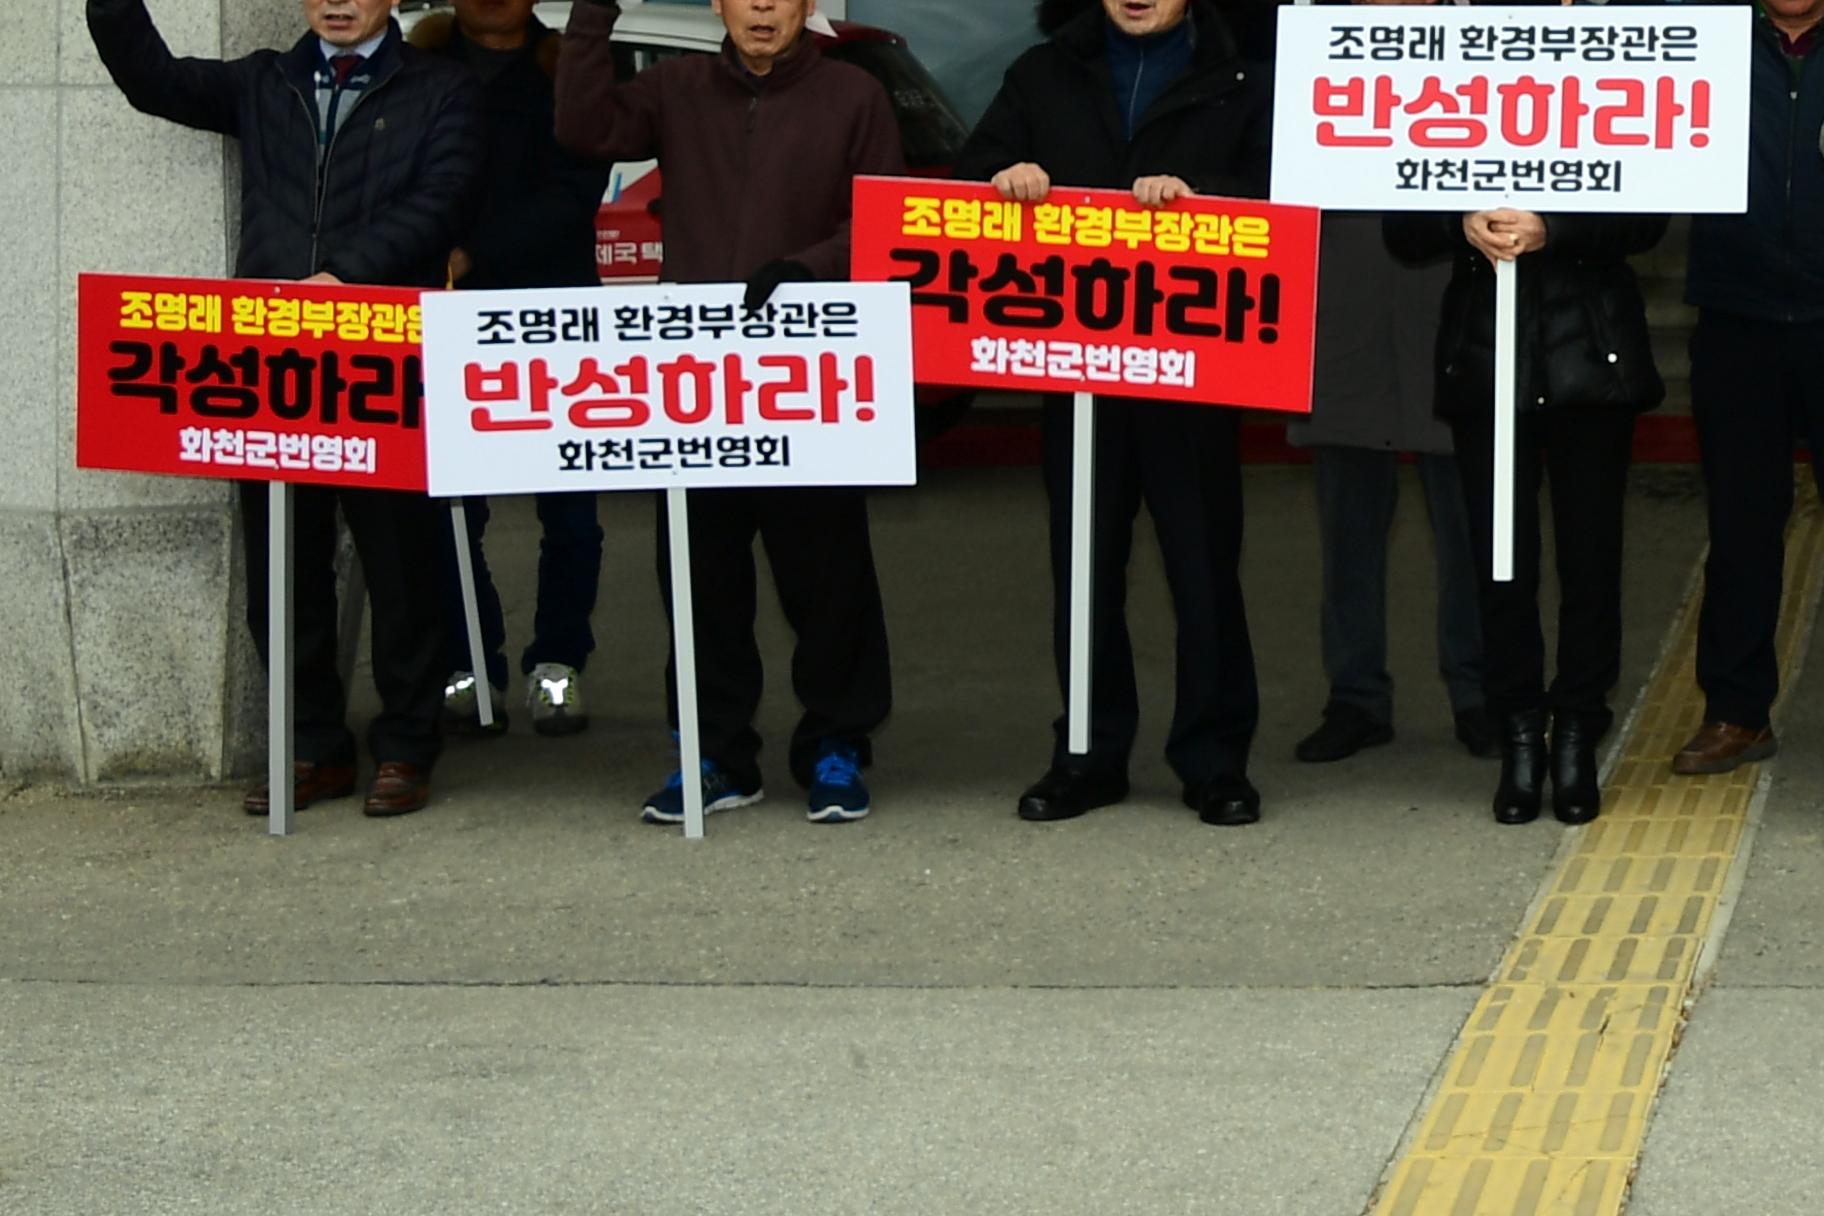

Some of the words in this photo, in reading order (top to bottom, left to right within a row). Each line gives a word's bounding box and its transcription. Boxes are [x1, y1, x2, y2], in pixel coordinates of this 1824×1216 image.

[1330, 25, 1445, 61] 조명래
[1461, 25, 1698, 62] 환경부장관은
[1313, 74, 1711, 150] 반성하라!
[1396, 159, 1622, 193] 화천군번영회
[902, 197, 1022, 241] 조명래
[1034, 203, 1271, 258] 환경부장관은
[120, 291, 222, 333] 조명래
[888, 249, 1280, 344] 각성하라!
[476, 307, 599, 345] 조명래
[613, 302, 859, 341] 환경부장관은
[970, 336, 1197, 388] 화천군번영회
[463, 351, 876, 433] 반성하라!
[180, 426, 377, 474] 화천군번영회
[557, 435, 791, 472] 화천군번영회
